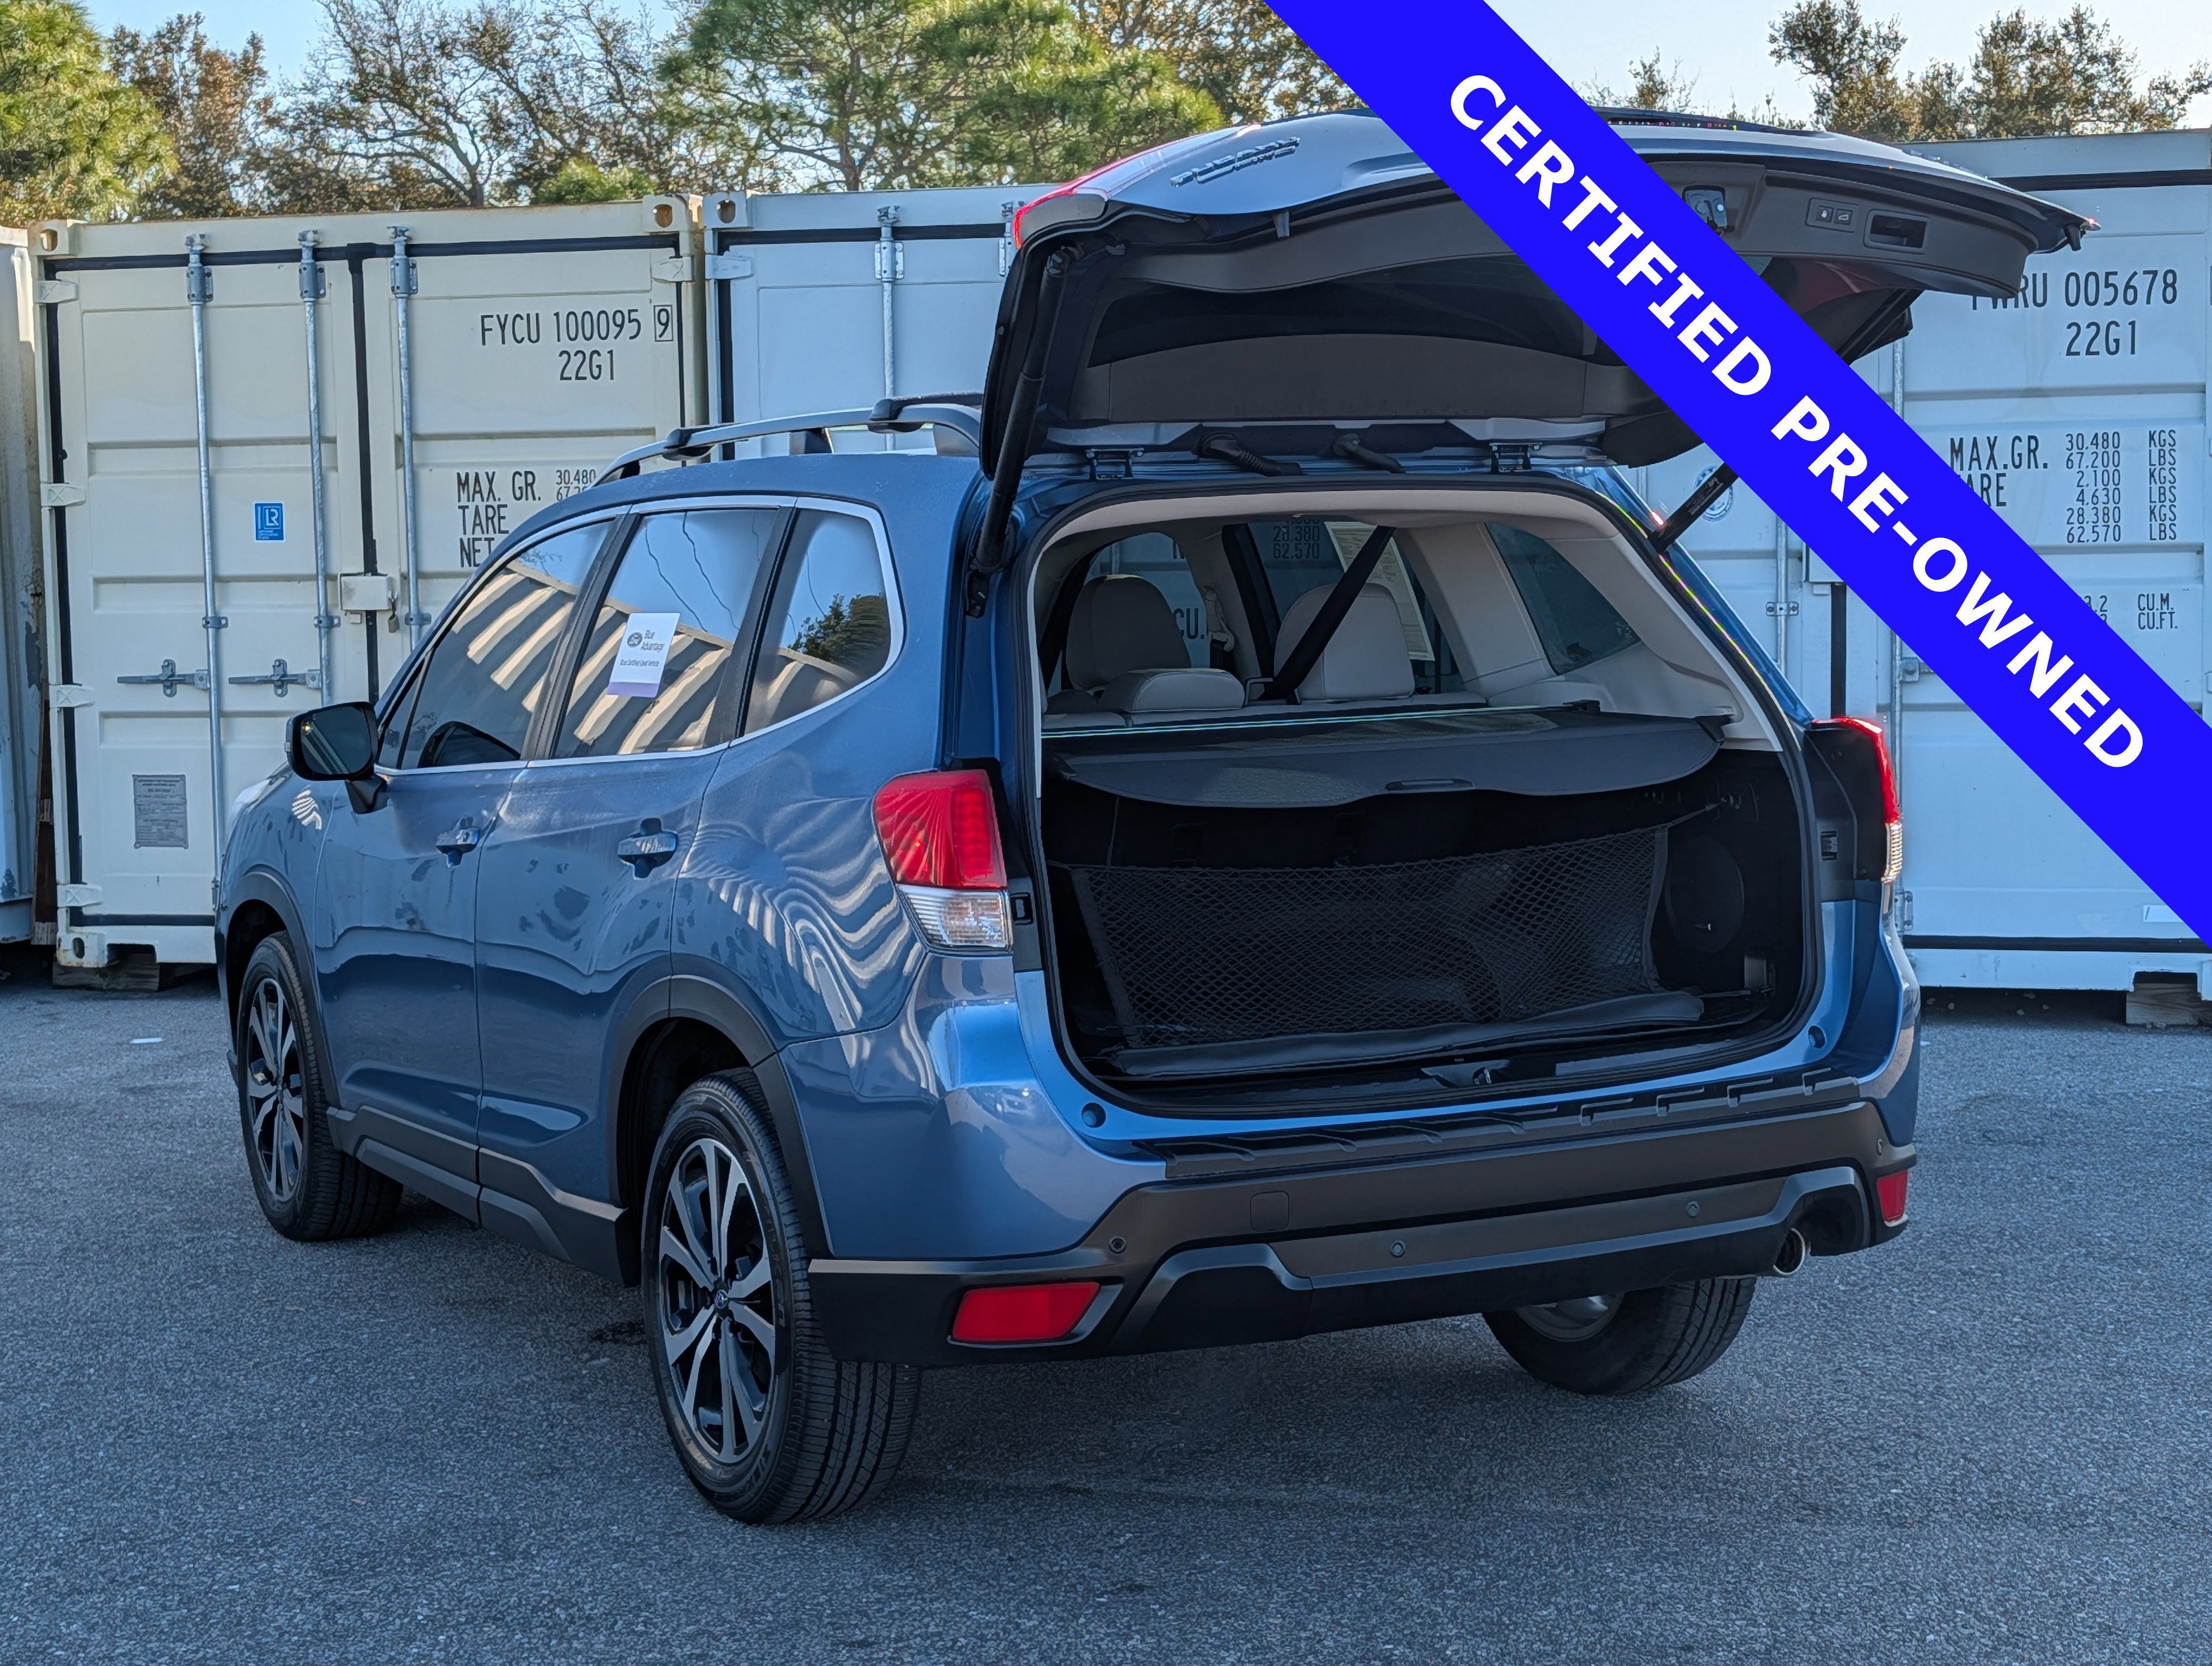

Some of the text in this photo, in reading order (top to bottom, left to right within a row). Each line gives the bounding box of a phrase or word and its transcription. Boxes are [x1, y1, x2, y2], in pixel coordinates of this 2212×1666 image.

[2065, 269, 2178, 307] 005678
[481, 308, 670, 345] FYCU 100095 9
[2066, 320, 2136, 356] 22G1
[558, 350, 615, 380] 22G1
[2149, 430, 2176, 447] KGS
[1950, 435, 2048, 471] MAX.GR.
[2149, 448, 2176, 466] LBS
[2149, 467, 2176, 485] KGS
[456, 471, 501, 503] MAX.
[512, 470, 541, 501] GR.
[2149, 485, 2176, 503] LBS
[458, 504, 509, 535] TARE
[2150, 504, 2176, 522] KGS
[2150, 523, 2176, 540] LBS
[2138, 593, 2174, 611] CU.M.
[2138, 611, 2178, 630] CU.FT.
